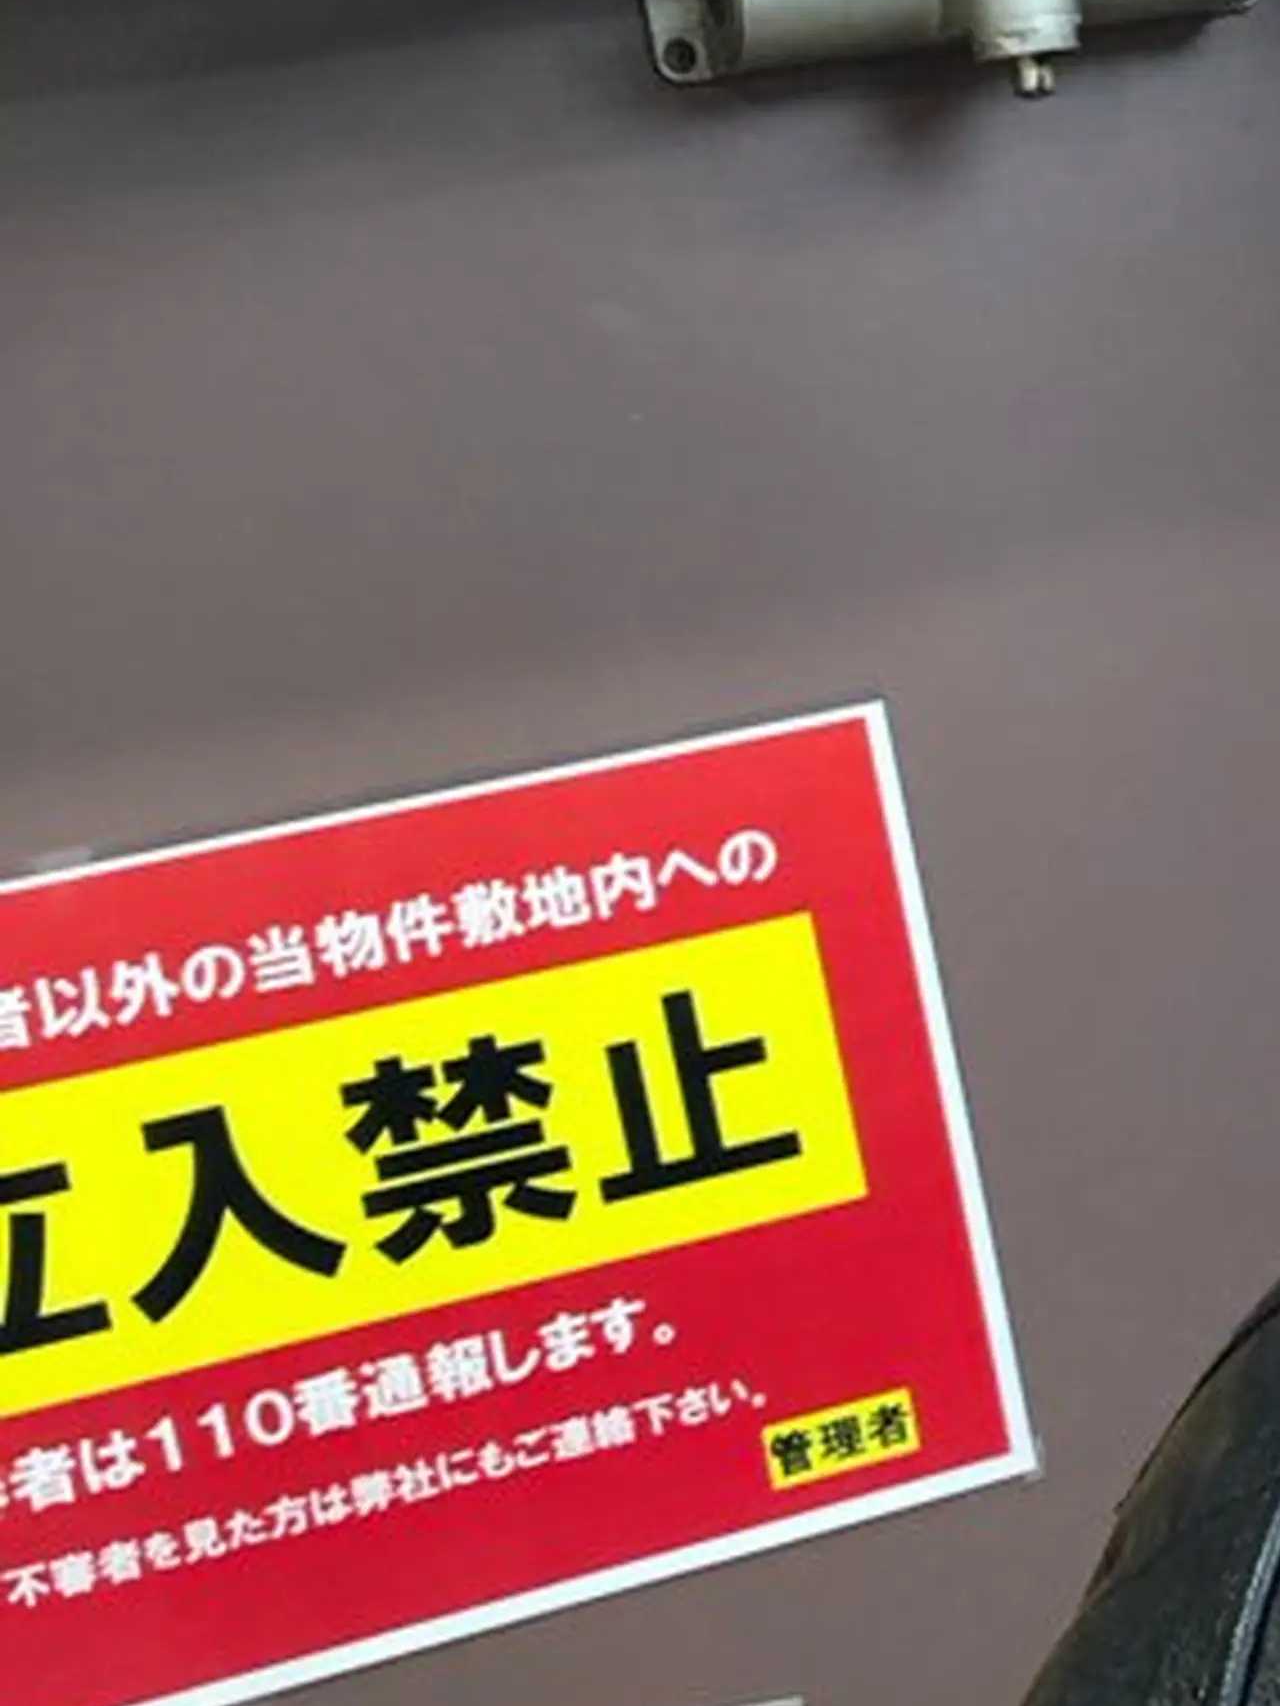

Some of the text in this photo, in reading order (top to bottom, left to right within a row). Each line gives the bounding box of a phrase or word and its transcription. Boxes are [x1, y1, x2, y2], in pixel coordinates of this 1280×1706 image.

[0, 991, 801, 1356] 立入禁止
[0, 1298, 675, 1515] 者は110番通報します。
[770, 1405, 908, 1477] 管理者
